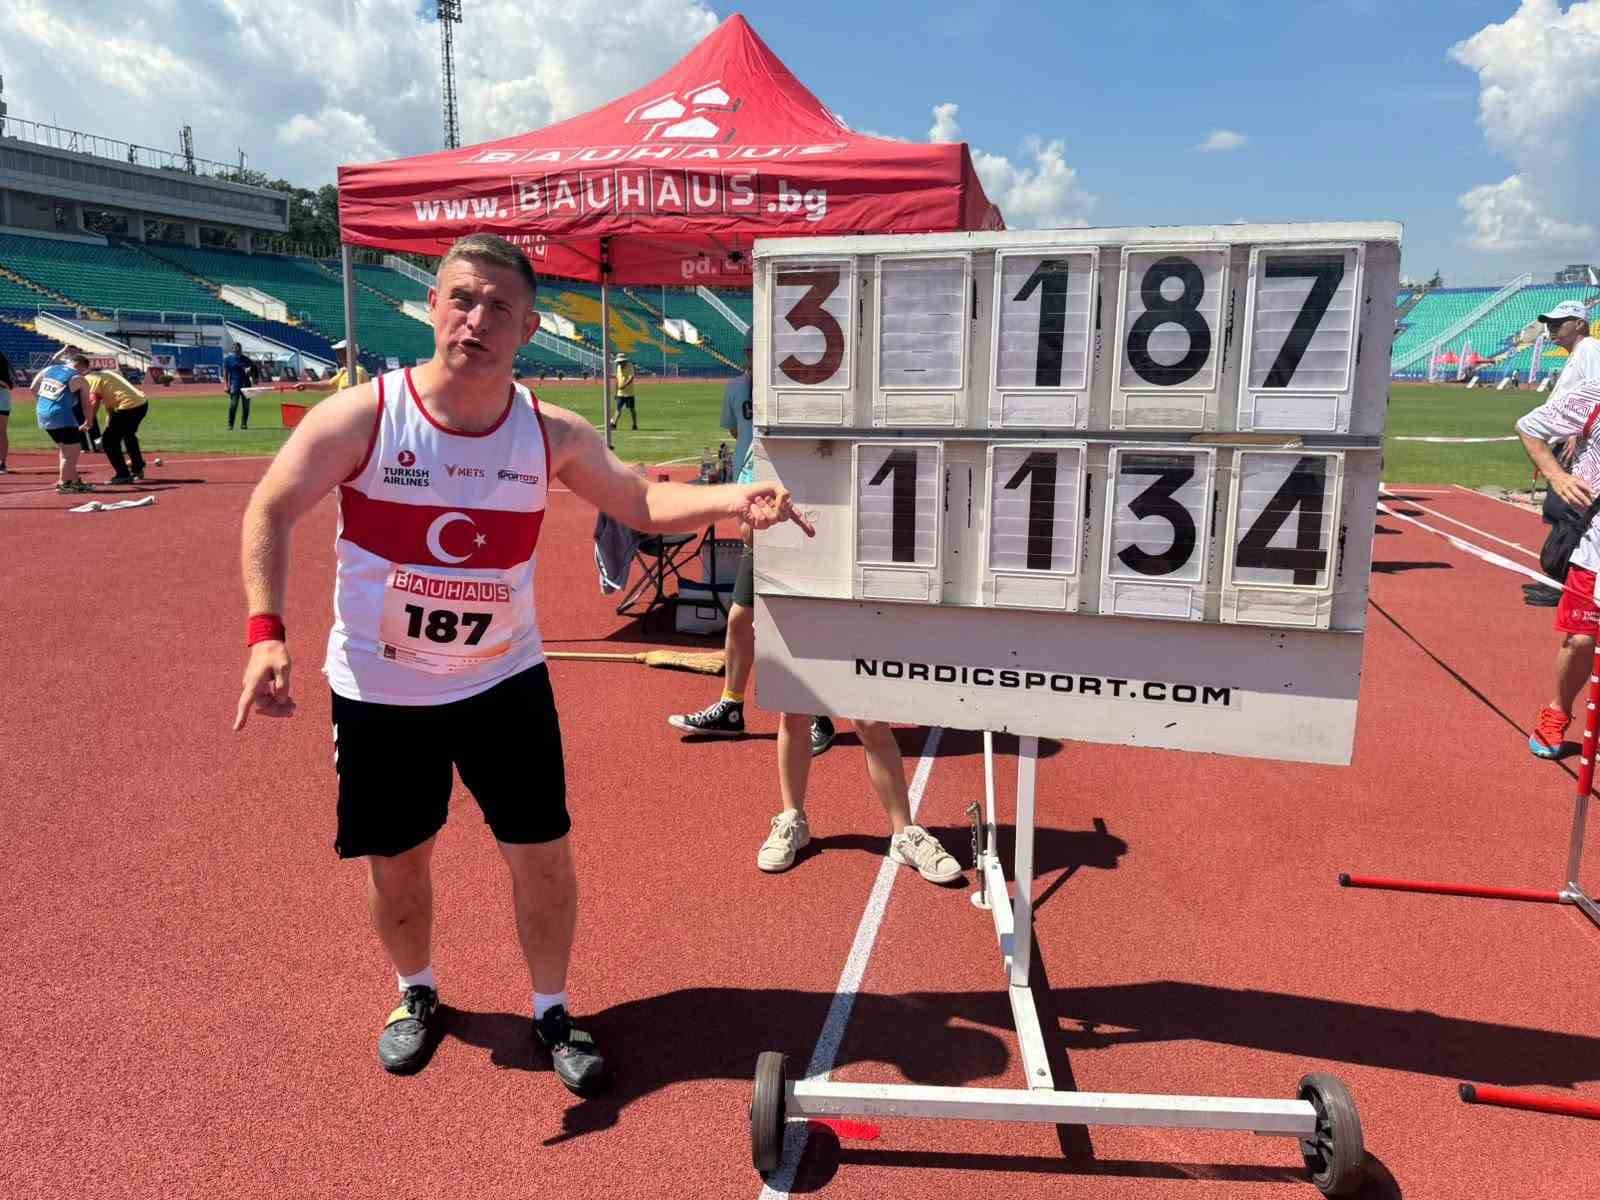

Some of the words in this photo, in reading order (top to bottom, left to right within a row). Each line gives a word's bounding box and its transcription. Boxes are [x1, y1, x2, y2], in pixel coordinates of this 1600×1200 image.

[476, 144, 848, 164] BAUHAUS
[383, 467, 430, 478] TURKISH
[383, 476, 430, 487] AIRLINES
[395, 571, 510, 601] BAUHAUS
[404, 604, 493, 646] 187
[855, 658, 1231, 706] NORDICSPORT.COM
